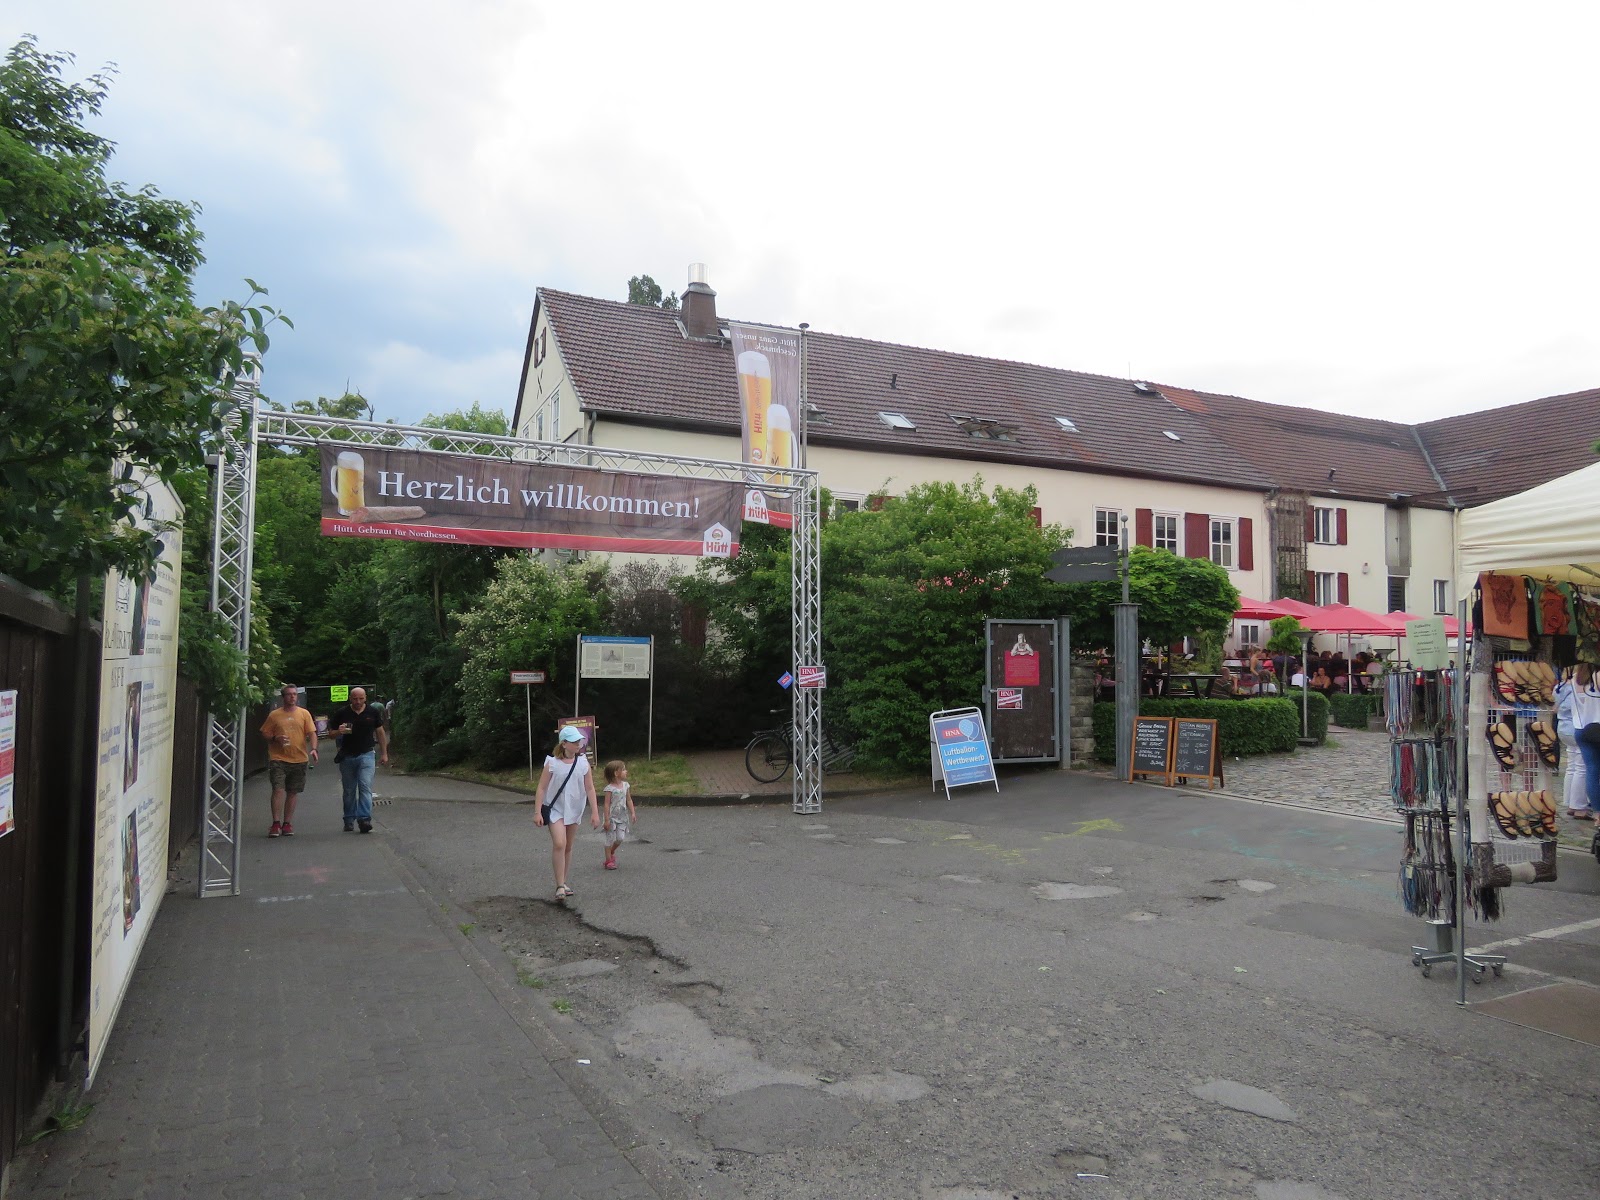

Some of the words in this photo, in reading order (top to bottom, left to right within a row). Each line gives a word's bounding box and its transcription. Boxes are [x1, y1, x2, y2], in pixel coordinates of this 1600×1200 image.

[378, 470, 510, 504] Herzlich
[519, 483, 700, 519] willkommen!
[358, 525, 392, 536] Gebraut
[394, 526, 407, 536] für
[408, 529, 459, 540] Nordhessen.
[705, 541, 729, 553] Hütt
[945, 729, 961, 737] HNA
[944, 747, 978, 757] Luftballon-
[946, 754, 985, 766] Wettbewerb
